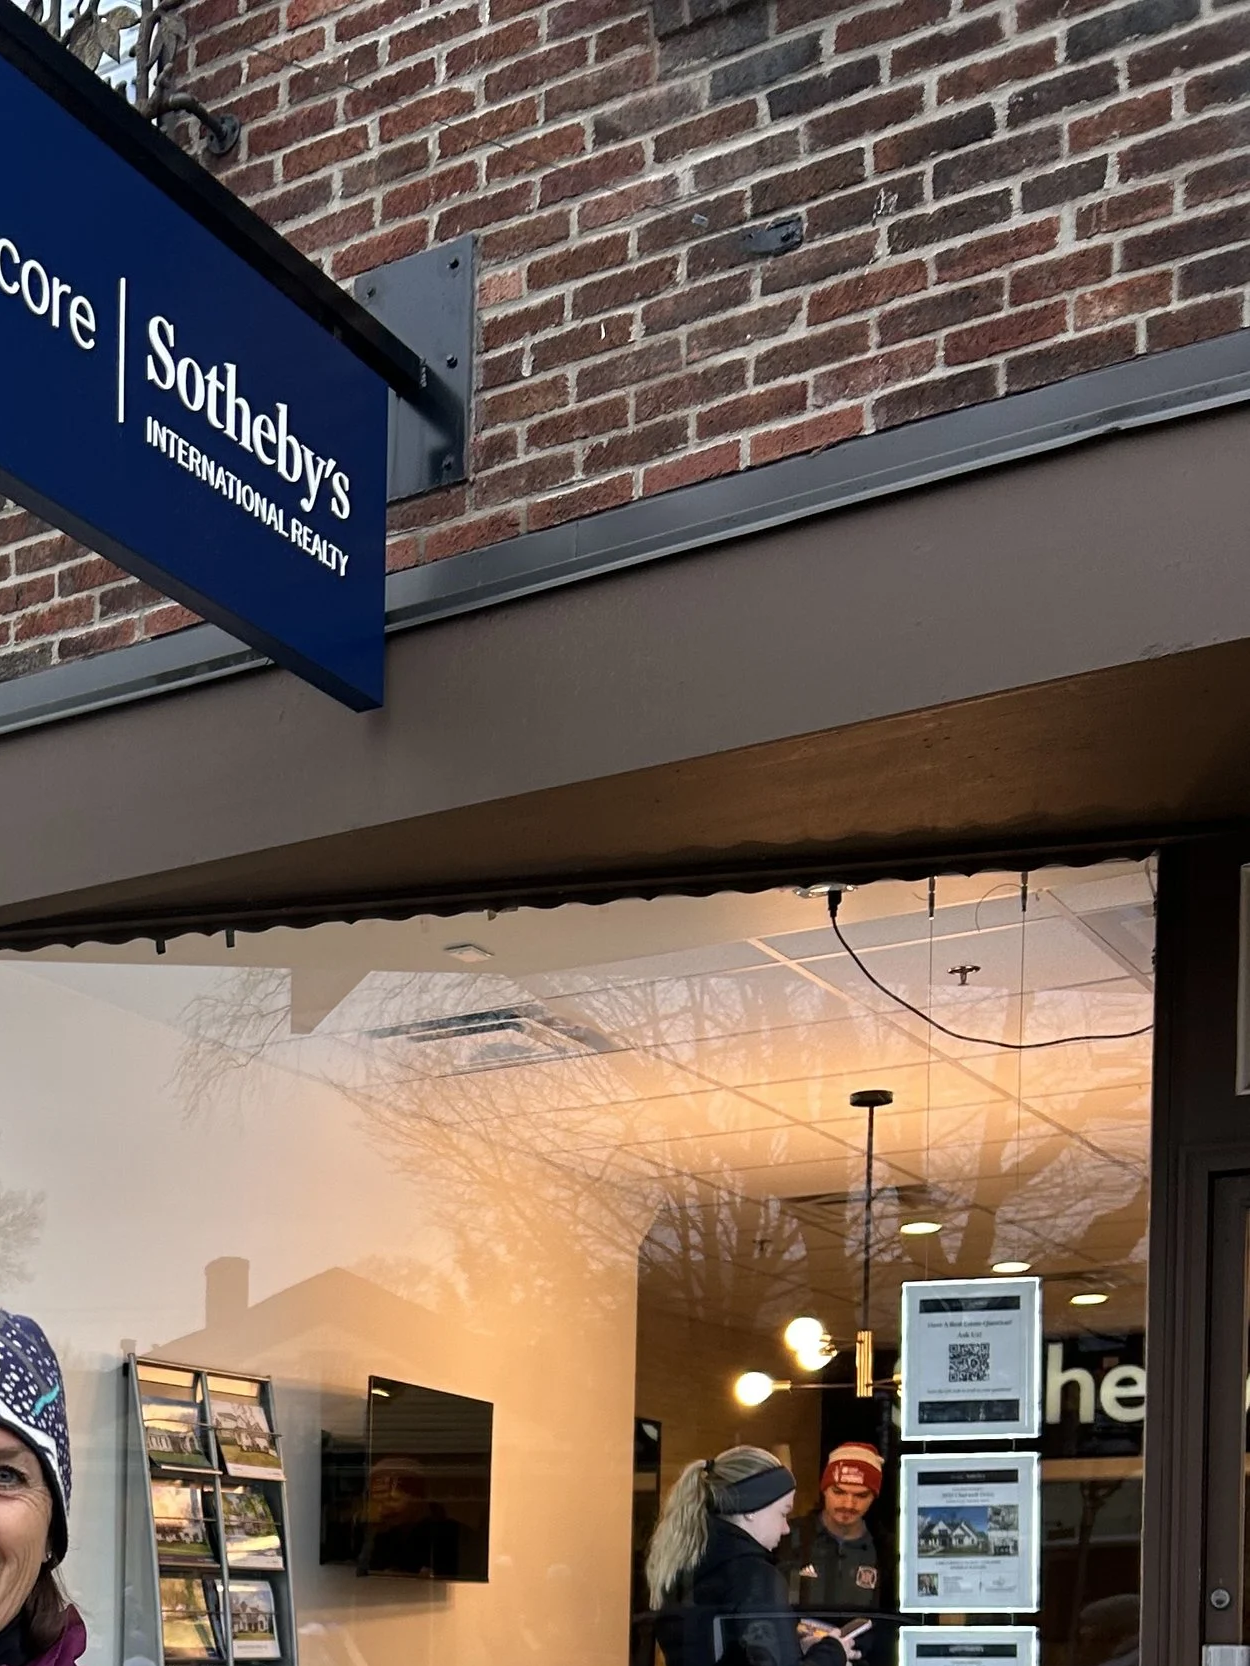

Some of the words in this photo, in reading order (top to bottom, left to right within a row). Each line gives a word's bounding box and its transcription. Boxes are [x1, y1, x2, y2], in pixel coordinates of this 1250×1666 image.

[146, 314, 350, 521] Sotheby's
[146, 416, 289, 538] INTERNATIONAL
[290, 521, 349, 577] REALTY
